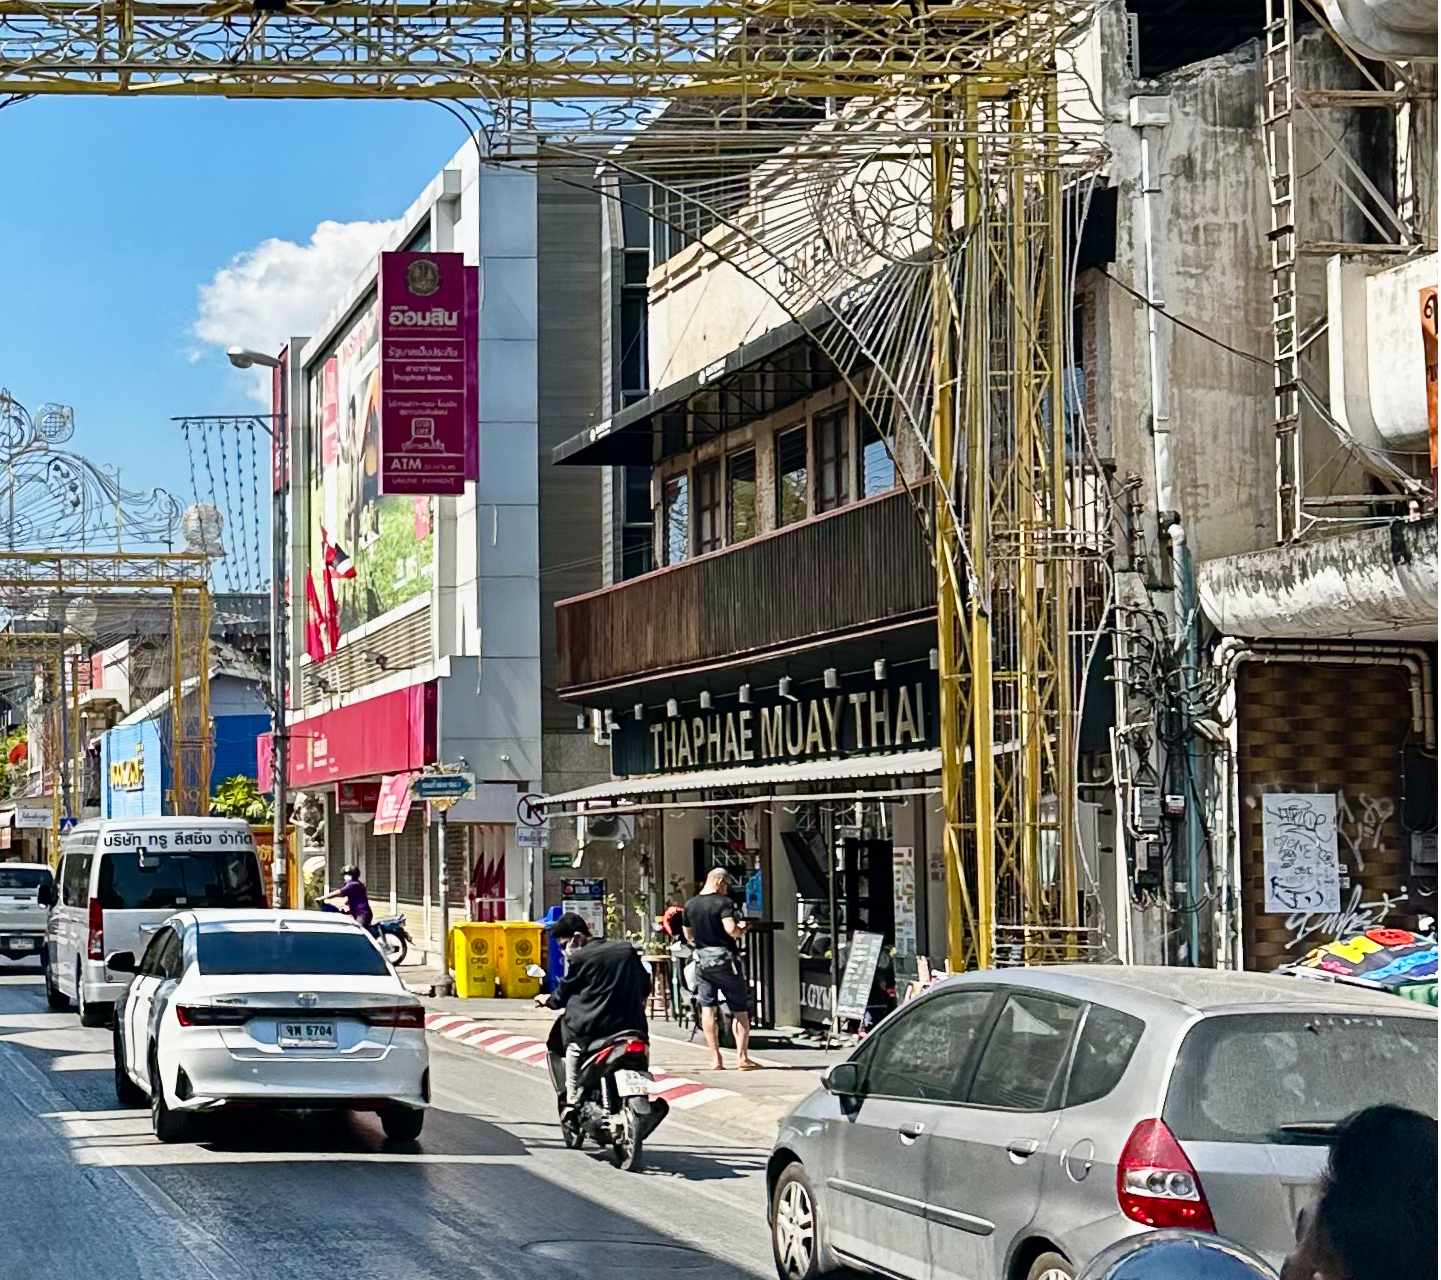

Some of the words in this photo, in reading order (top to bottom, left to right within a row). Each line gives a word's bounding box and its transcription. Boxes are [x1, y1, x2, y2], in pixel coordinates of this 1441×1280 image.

[388, 307, 458, 326] ออมสิน
[390, 459, 422, 470] ATM
[649, 710, 754, 769] THAPHAE
[760, 695, 843, 758] MUAY
[849, 683, 926, 749] THAI
[103, 832, 142, 847] บริษัท
[148, 834, 168, 849] ทรู
[174, 828, 212, 846] ลีสซิ่ง
[219, 830, 253, 845] จำกัด
